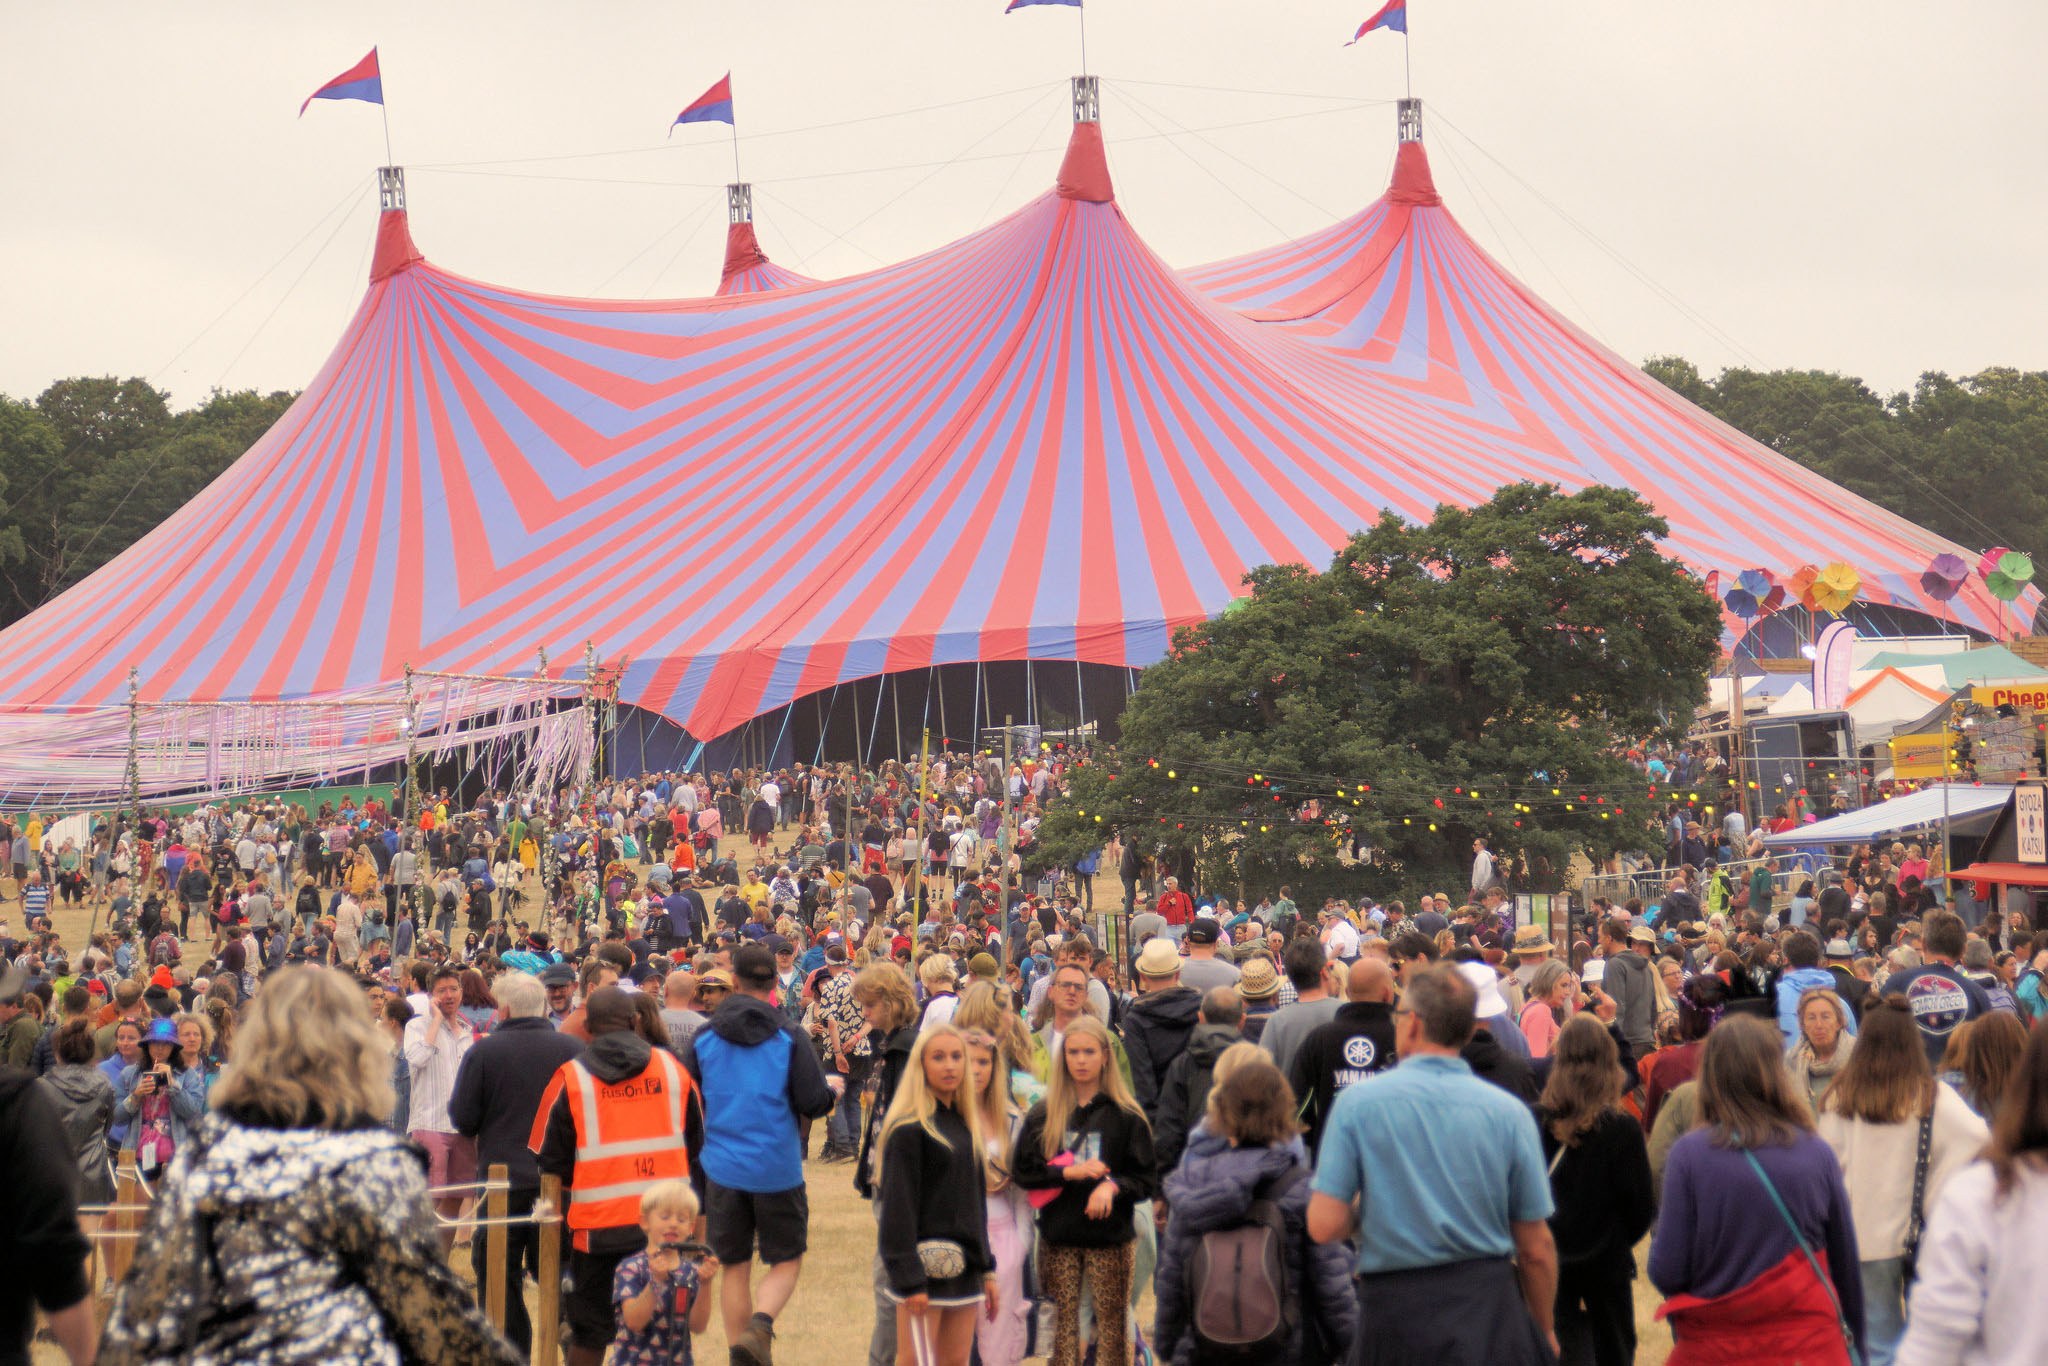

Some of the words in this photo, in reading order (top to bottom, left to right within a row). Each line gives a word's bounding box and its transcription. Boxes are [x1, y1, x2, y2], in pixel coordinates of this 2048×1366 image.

[1993, 689, 2048, 710] Chee
[2019, 794, 2042, 811] GYOZA
[2022, 837, 2043, 855] KATSU
[1334, 1070, 1376, 1084] YAMAH
[634, 1157, 656, 1177] 142
